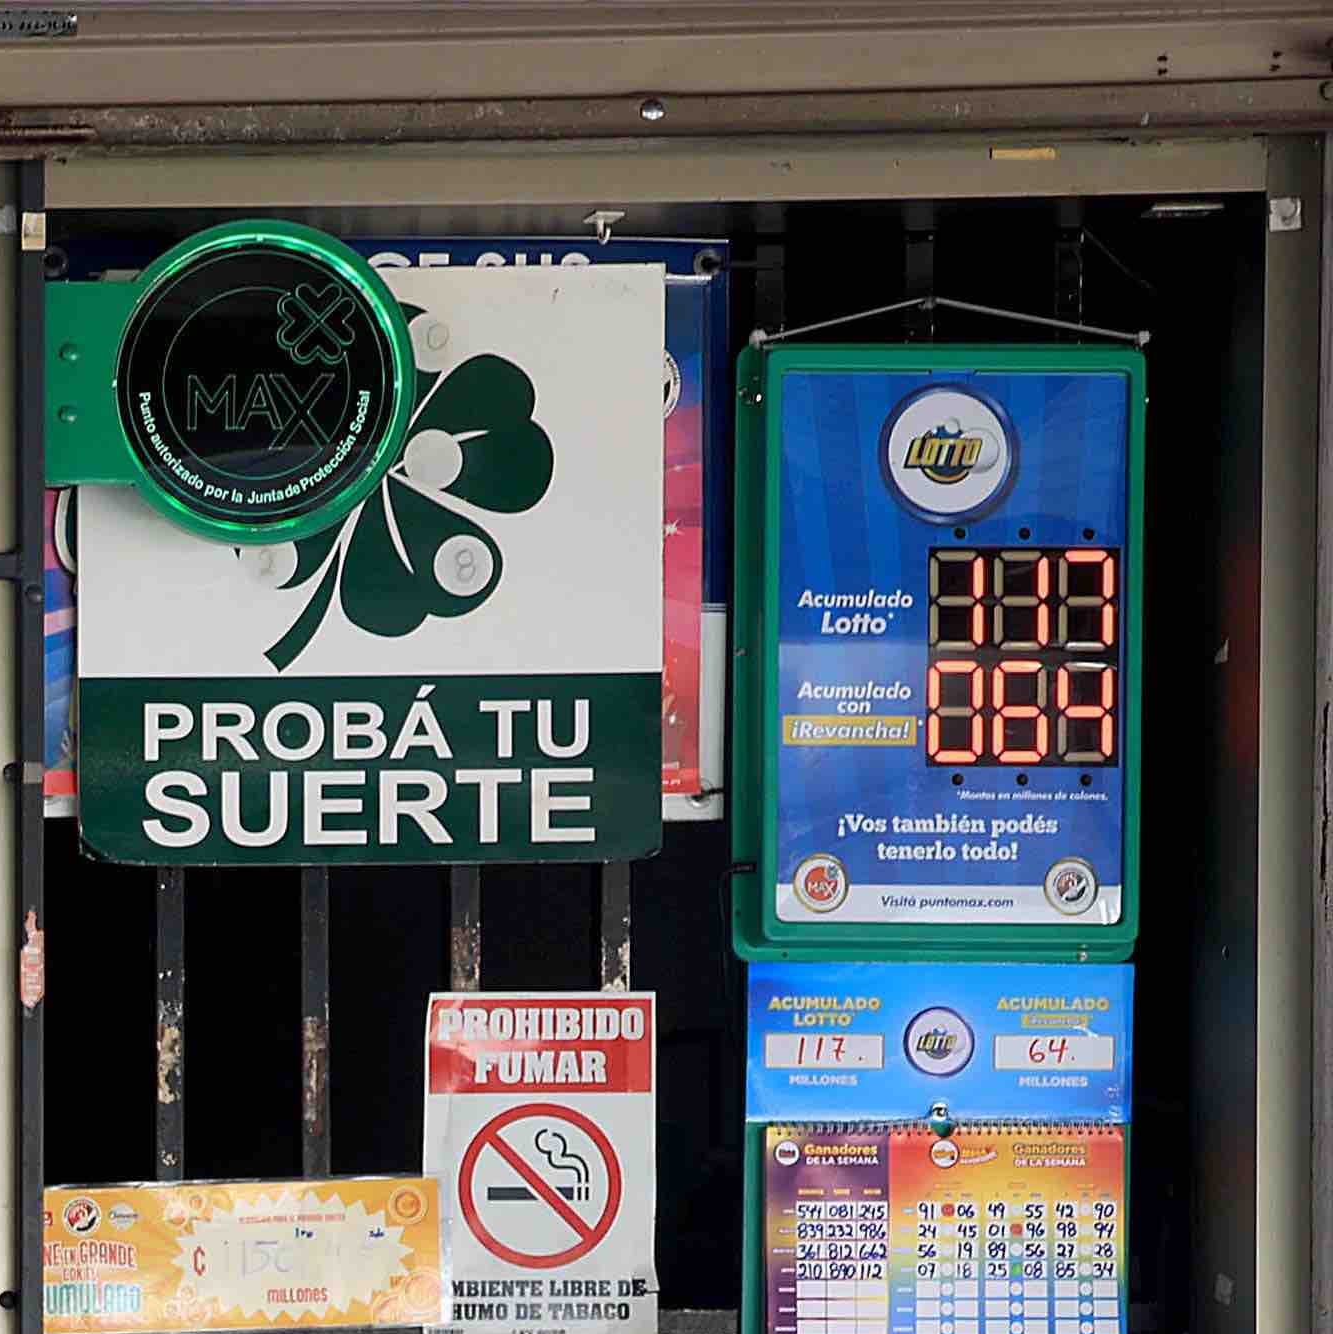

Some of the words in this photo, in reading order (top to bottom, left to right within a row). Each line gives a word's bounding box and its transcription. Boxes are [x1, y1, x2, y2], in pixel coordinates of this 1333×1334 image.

[187, 373, 336, 450] MAX
[139, 391, 156, 433] Punto
[150, 432, 204, 491] autorizado
[204, 483, 229, 503] por
[231, 488, 243, 504] la
[247, 490, 284, 505] Junta
[300, 434, 357, 492] Protección
[349, 389, 371, 434] Social
[904, 437, 982, 469] LOTTO
[797, 589, 913, 608] Acumulado
[797, 681, 912, 699] Acumulado
[837, 701, 871, 713] con
[927, 659, 1114, 765] 064
[144, 685, 452, 761] PROBÁ
[479, 699, 590, 760] TU
[143, 768, 596, 848] SUERTE
[837, 814, 886, 837] ¡Vos
[893, 813, 985, 834] también
[991, 814, 1058, 838] podés
[878, 841, 956, 861] tenerlo
[961, 840, 1018, 861] todo!
[881, 895, 917, 908] Visitá
[920, 896, 1014, 910] puntomax.com
[768, 996, 881, 1011] ACUMULADO
[997, 996, 1109, 1011] ACUMULADO
[438, 1005, 644, 1042] PROHIBIDO
[793, 1013, 852, 1027] LOTTO
[474, 1048, 607, 1084] FUMAR
[789, 1075, 858, 1087] MILLONES
[1019, 1076, 1089, 1088] MILLONES
[804, 1144, 878, 1157] Ganadores
[1013, 1143, 1085, 1157] Ganadores
[807, 1156, 819, 1165] DE
[822, 1156, 836, 1165] LA
[838, 1156, 879, 1166] SEMANA
[918, 1203, 934, 1220] 91
[957, 1204, 975, 1218] 06
[988, 1202, 1005, 1218] 49
[1025, 1204, 1044, 1218] 55
[1055, 1202, 1074, 1219] 42
[1094, 1202, 1114, 1220] 90
[798, 1223, 823, 1239] 839
[828, 1223, 853, 1238] 232
[859, 1223, 886, 1239] 986
[918, 1224, 937, 1238] 24
[957, 1224, 977, 1238] 45
[988, 1224, 1005, 1237] 01
[1025, 1222, 1045, 1238] 96
[1057, 1222, 1077, 1238] 98
[1094, 1222, 1113, 1239] 94
[452, 1279, 543, 1297] MBIENTE
[550, 1279, 614, 1297] LIBRE
[618, 1278, 647, 1297] DE
[452, 1303, 508, 1320] HUMO
[515, 1303, 542, 1320] DE
[548, 1302, 631, 1320] TABACO
